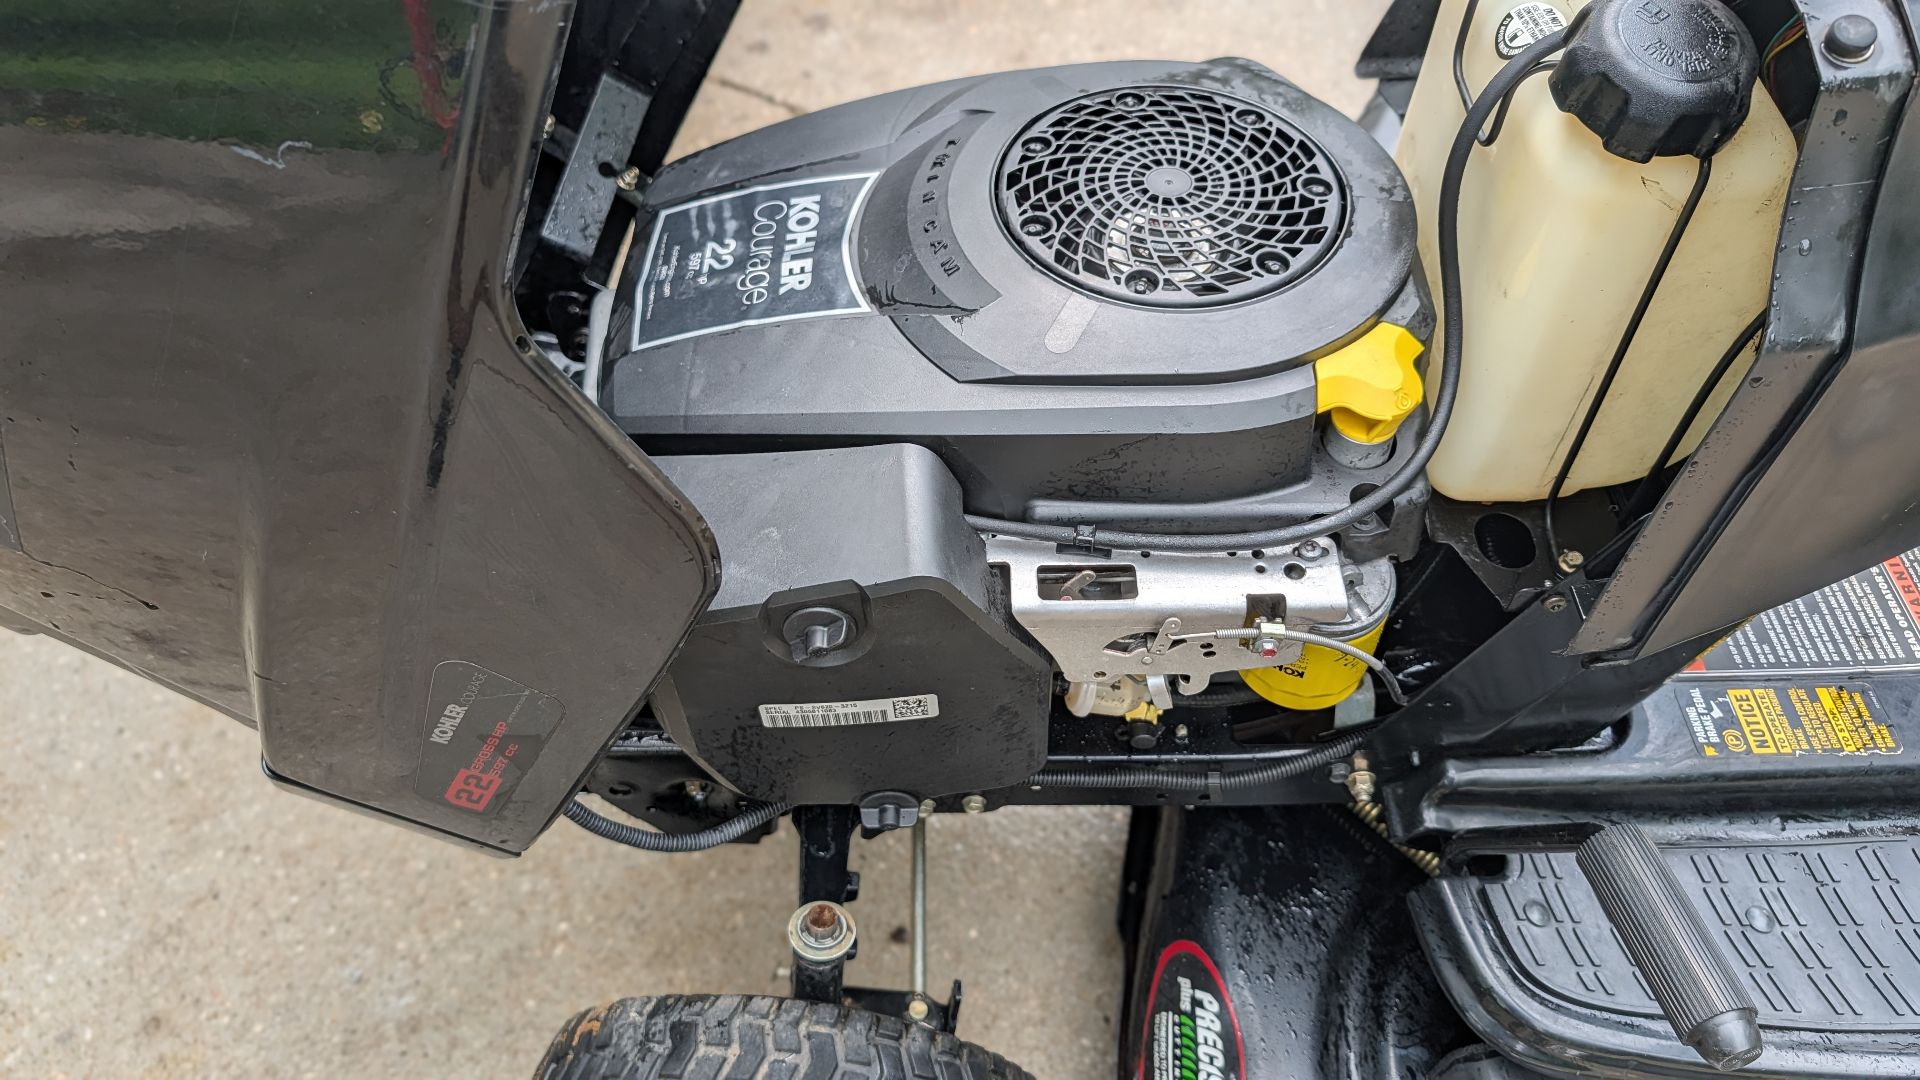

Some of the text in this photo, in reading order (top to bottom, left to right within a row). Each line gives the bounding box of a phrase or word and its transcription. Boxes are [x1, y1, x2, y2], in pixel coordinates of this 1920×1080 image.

[702, 238, 737, 274] 22
[736, 200, 788, 305] Courage
[778, 194, 821, 295] KOHLER
[924, 220, 961, 277] CAM
[687, 253, 702, 270] 597
[1818, 602, 1829, 614] AND
[1829, 595, 1838, 607] AND
[1835, 591, 1849, 610] HANDS
[1870, 566, 1907, 627] OPERATOR'S
[1802, 612, 1818, 636] OBJECTS
[1824, 614, 1842, 642] LOCATION
[1834, 608, 1851, 634] BLADE(S)
[1845, 611, 1861, 636] PLACING
[1858, 611, 1874, 635] LEAVING
[1861, 581, 1905, 657] SHUT OFF AND REMOVE KEY.
[1767, 629, 1784, 655] MACHINE
[1778, 633, 1790, 648] BACK
[1787, 624, 1801, 645] SAFETY
[1825, 641, 1835, 652] THE
[1848, 635, 1860, 650] SURE
[1871, 635, 1886, 658] BEFORE
[1874, 625, 1895, 658] DISENGAGE
[1742, 645, 1753, 663] AVOID
[1752, 642, 1762, 653] NOT
[1758, 654, 1766, 662] DO
[1767, 654, 1775, 662] OR
[1787, 649, 1797, 662] AND
[1797, 646, 1809, 661] KEEP
[1807, 649, 1818, 661] AND
[1813, 637, 1830, 660] REMOVE
[1831, 652, 1840, 660] BY
[1839, 642, 1852, 660] KNOW
[1855, 651, 1864, 659] BE
[1859, 636, 1873, 659] BEFORE
[429, 671, 488, 744] KOHLER COURAGE
[1689, 687, 1720, 742] BRAKE PEDAL
[1786, 687, 1821, 748] USE SPEED CONTROL
[1796, 688, 1831, 748] LEVER TO REGULATE
[1827, 686, 1863, 747] MOVE SPEED CONTROL
[1851, 692, 1871, 720] PARKING
[1685, 706, 1708, 742] PARKING
[1733, 694, 1770, 748] NOTICE
[1757, 692, 1787, 749] TO OPERATE:
[1765, 688, 1798, 749] DISENGAGE PARKING
[1812, 700, 1840, 747] GROUND SPEED.
[1828, 707, 1852, 747] TO STOP:
[1853, 718, 1862, 726] TO
[1793, 726, 1809, 749] BRAKE.
[1858, 727, 1873, 747] LEVER
[1865, 721, 1885, 746] ENGAGE
[1877, 722, 1895, 746] BRAKE.
[454, 721, 508, 804] 22 GROSS HP
[488, 756, 508, 778] 597
[1177, 975, 1193, 1013] plus
[1154, 1014, 1160, 1023] TO
[1160, 1011, 1168, 1059] ENGINEERED
[1160, 1060, 1167, 1070] TO
